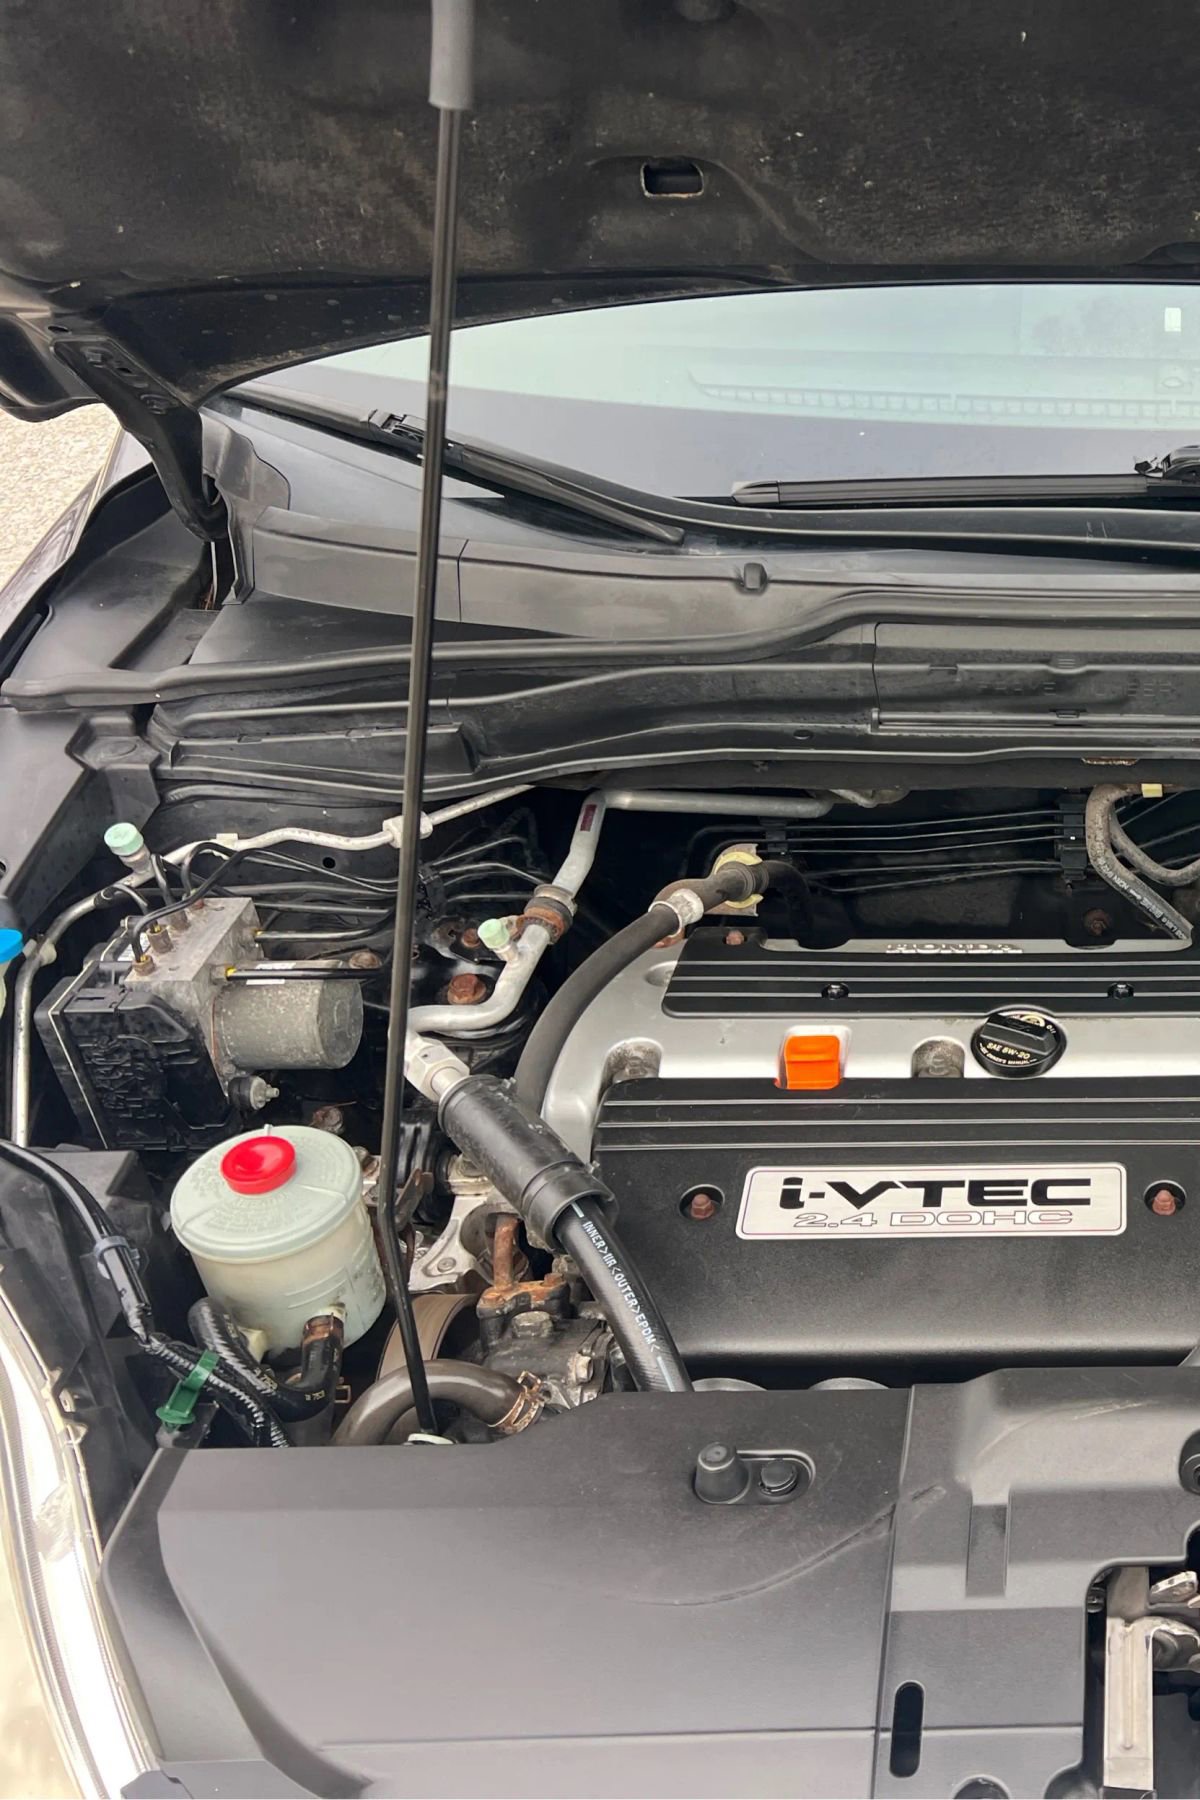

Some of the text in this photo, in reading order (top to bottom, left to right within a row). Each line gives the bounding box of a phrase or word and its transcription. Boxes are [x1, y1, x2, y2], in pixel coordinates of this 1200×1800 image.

[886, 942, 1023, 954] HONDA
[986, 1042, 1002, 1053] SAE
[779, 1176, 1092, 1210] i-VTEC
[793, 1210, 1073, 1228] 2.4 DOHC
